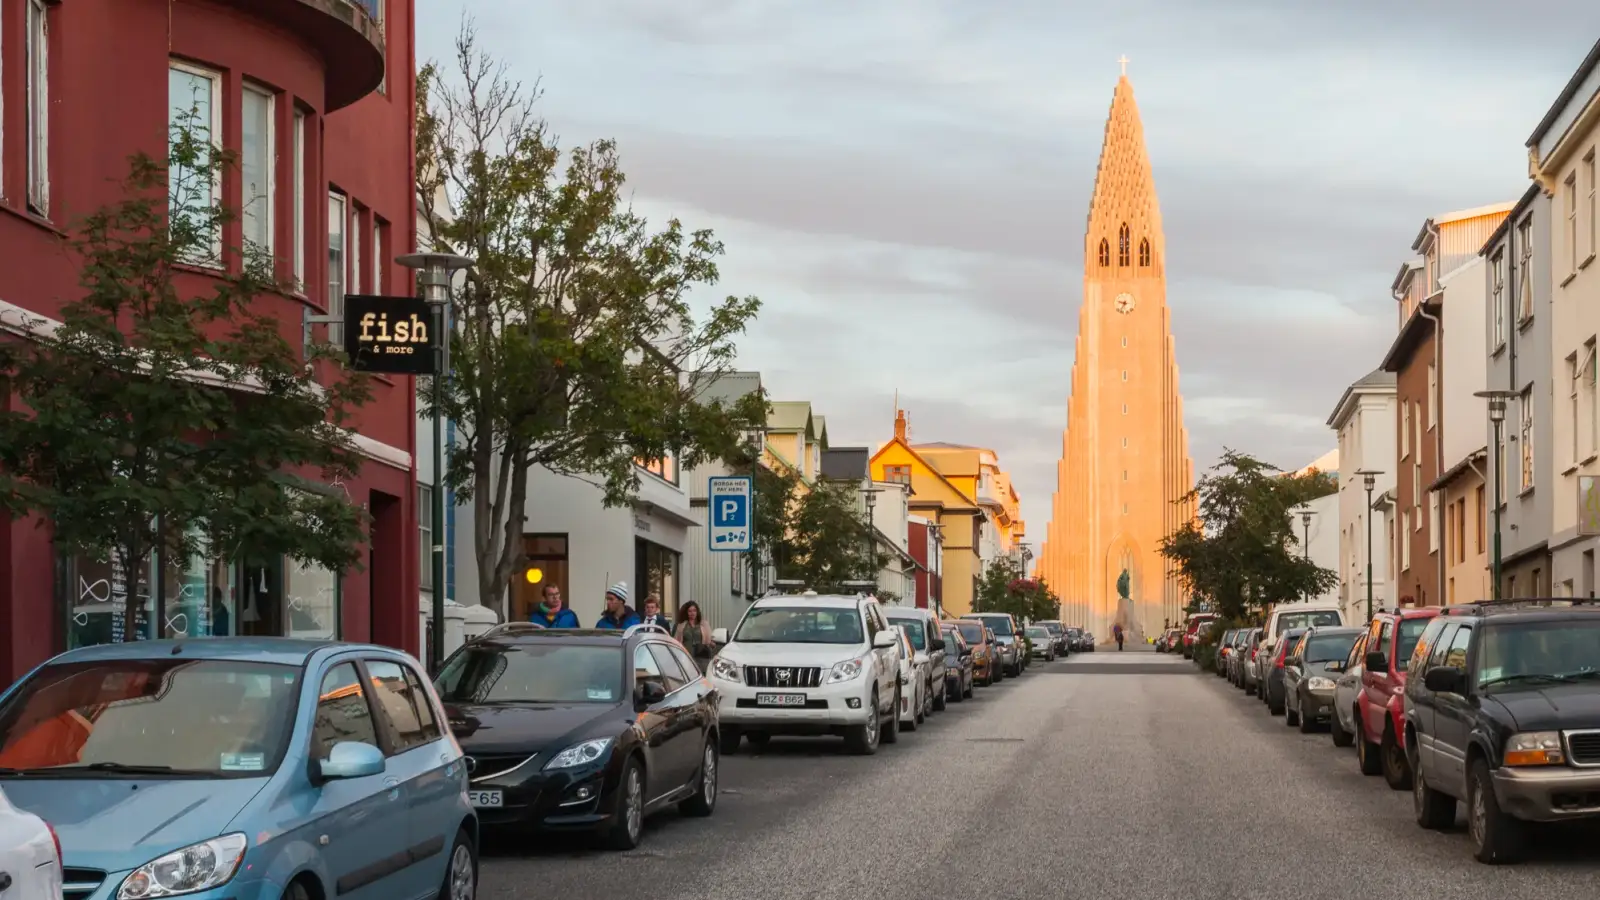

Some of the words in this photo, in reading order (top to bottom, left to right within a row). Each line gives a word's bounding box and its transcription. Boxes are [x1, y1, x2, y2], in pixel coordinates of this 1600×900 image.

[359, 312, 429, 343] fish
[373, 345, 380, 354] &
[386, 346, 414, 354] more
[722, 500, 738, 522] P
[763, 695, 778, 704] RZ
